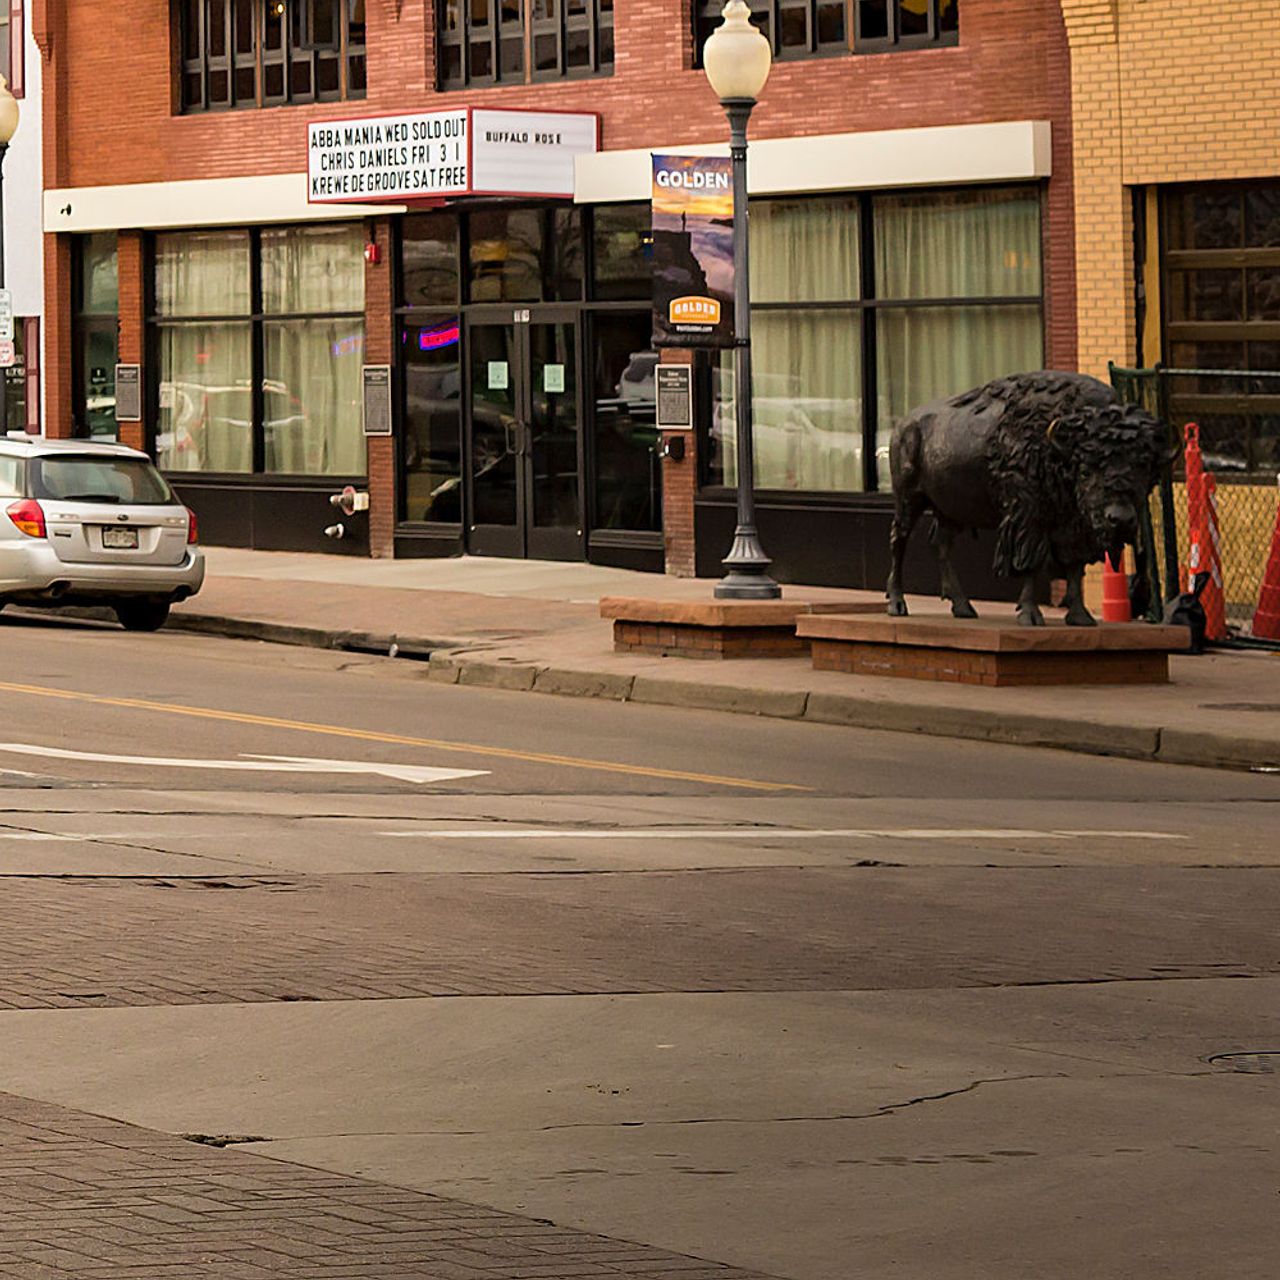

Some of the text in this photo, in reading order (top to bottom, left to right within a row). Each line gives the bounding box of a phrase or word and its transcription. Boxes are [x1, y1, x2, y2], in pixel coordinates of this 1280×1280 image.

[311, 118, 466, 148] ABBA MANIA WED SOLD OUT
[486, 131, 562, 144] BUFFALO ROSE
[321, 151, 355, 171] CHRIS
[359, 147, 408, 169] DANIELS
[412, 144, 430, 164] FRI
[312, 166, 466, 196] KREWE DE GROOVE SAT FREE
[656, 170, 728, 189] GOLDEN
